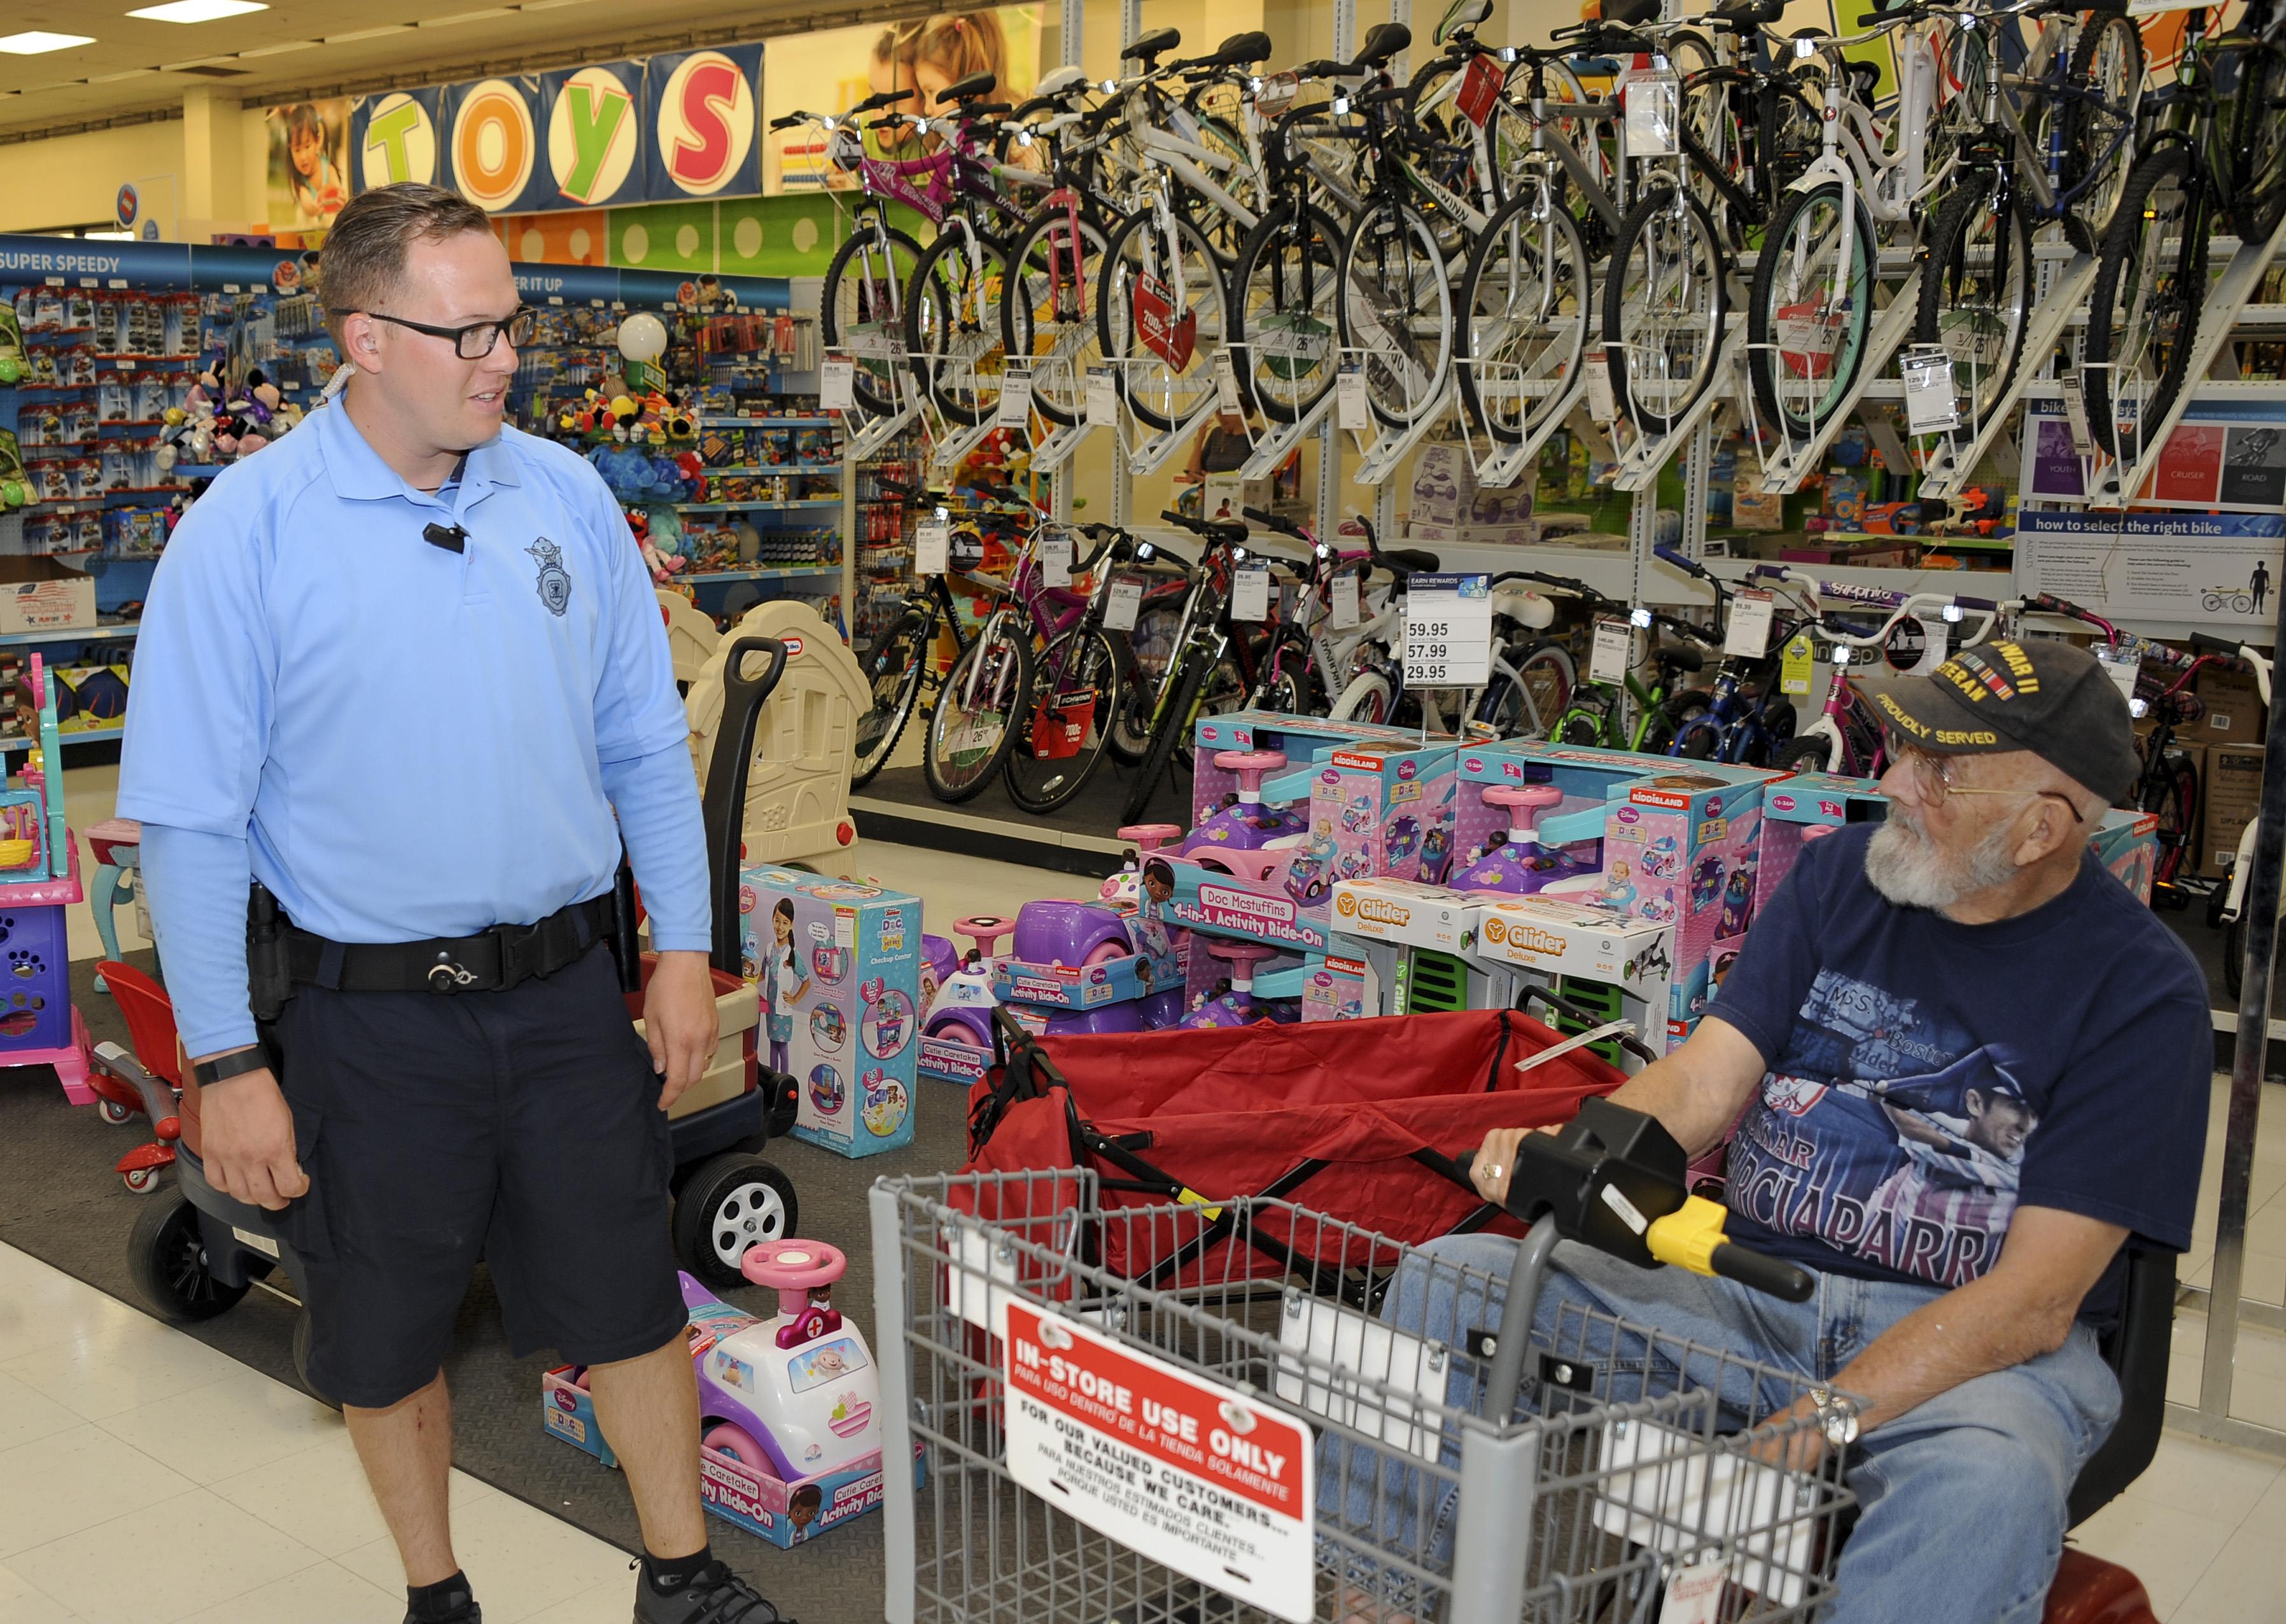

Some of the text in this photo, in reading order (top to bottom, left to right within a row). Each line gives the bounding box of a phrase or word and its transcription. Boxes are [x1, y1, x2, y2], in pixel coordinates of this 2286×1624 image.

[367, 60, 743, 204] TOYS
[0, 253, 120, 273] SUPER SPEEDY
[531, 276, 543, 291] IT
[545, 277, 563, 291] UP
[1296, 335, 1314, 351] 26"
[2041, 400, 2137, 417] bike ey:
[2171, 471, 2205, 479] CRUISER
[2241, 473, 2267, 482] ROAD
[2036, 518, 2222, 536] how to select the right bike
[2026, 539, 2034, 569] ADULTS
[1409, 623, 1448, 636] 59.95
[1408, 645, 1447, 658] 57.99
[1814, 643, 1873, 665] inep
[1998, 643, 2034, 677] WAR
[1407, 666, 1446, 679] 29.95
[1875, 692, 1932, 739] PROUDLY
[972, 730, 988, 743] 26"
[1935, 730, 1998, 745] SERVED
[1334, 755, 1378, 770] KIDDIELAND
[1632, 792, 1684, 808] KIDDIELAND
[1772, 799, 1795, 808] 12-36M
[1207, 891, 1286, 917] Doc Mcstuffins
[1359, 899, 1410, 927] Glider
[1172, 902, 1324, 948] 4-in-1 Activity Ride-On
[1357, 921, 1384, 934] Deluxe
[1509, 927, 1566, 955] Glider
[870, 953, 912, 965] Checkup Center
[1507, 949, 1536, 963] Deluxe
[1327, 960, 1364, 976] KIDDIELAN
[866, 980, 877, 990] 10
[1018, 978, 1060, 990] Cutie Caretaker
[1011, 988, 1070, 1005] Activity Ride-On
[925, 1045, 979, 1063] Cutie Caretaker
[867, 1071, 877, 1081] 25
[951, 1061, 986, 1077] Ride-O
[554, 1389, 576, 1410] Disney
[1015, 1338, 1287, 1480] IN-STORE USE ONLY
[1014, 1364, 1290, 1502] PARA USO DENTRO DE LA TIENDA SOLAMENTE
[1020, 1399, 1290, 1537] FOR OUR VALUED CUSTOMERS...
[710, 1466, 757, 1495] Caretaker
[836, 1474, 883, 1501] Cutie Caret
[1064, 1439, 1232, 1530] BECAUSE WE CARE.
[719, 1485, 773, 1528] Ride-On
[820, 1495, 866, 1527] Activity
[1037, 1443, 1266, 1562] PARA NUESTROS ESTIMADOS CLIENTES...
[1057, 1467, 1238, 1563] PORQUE USTED ES IMPORTANTE
